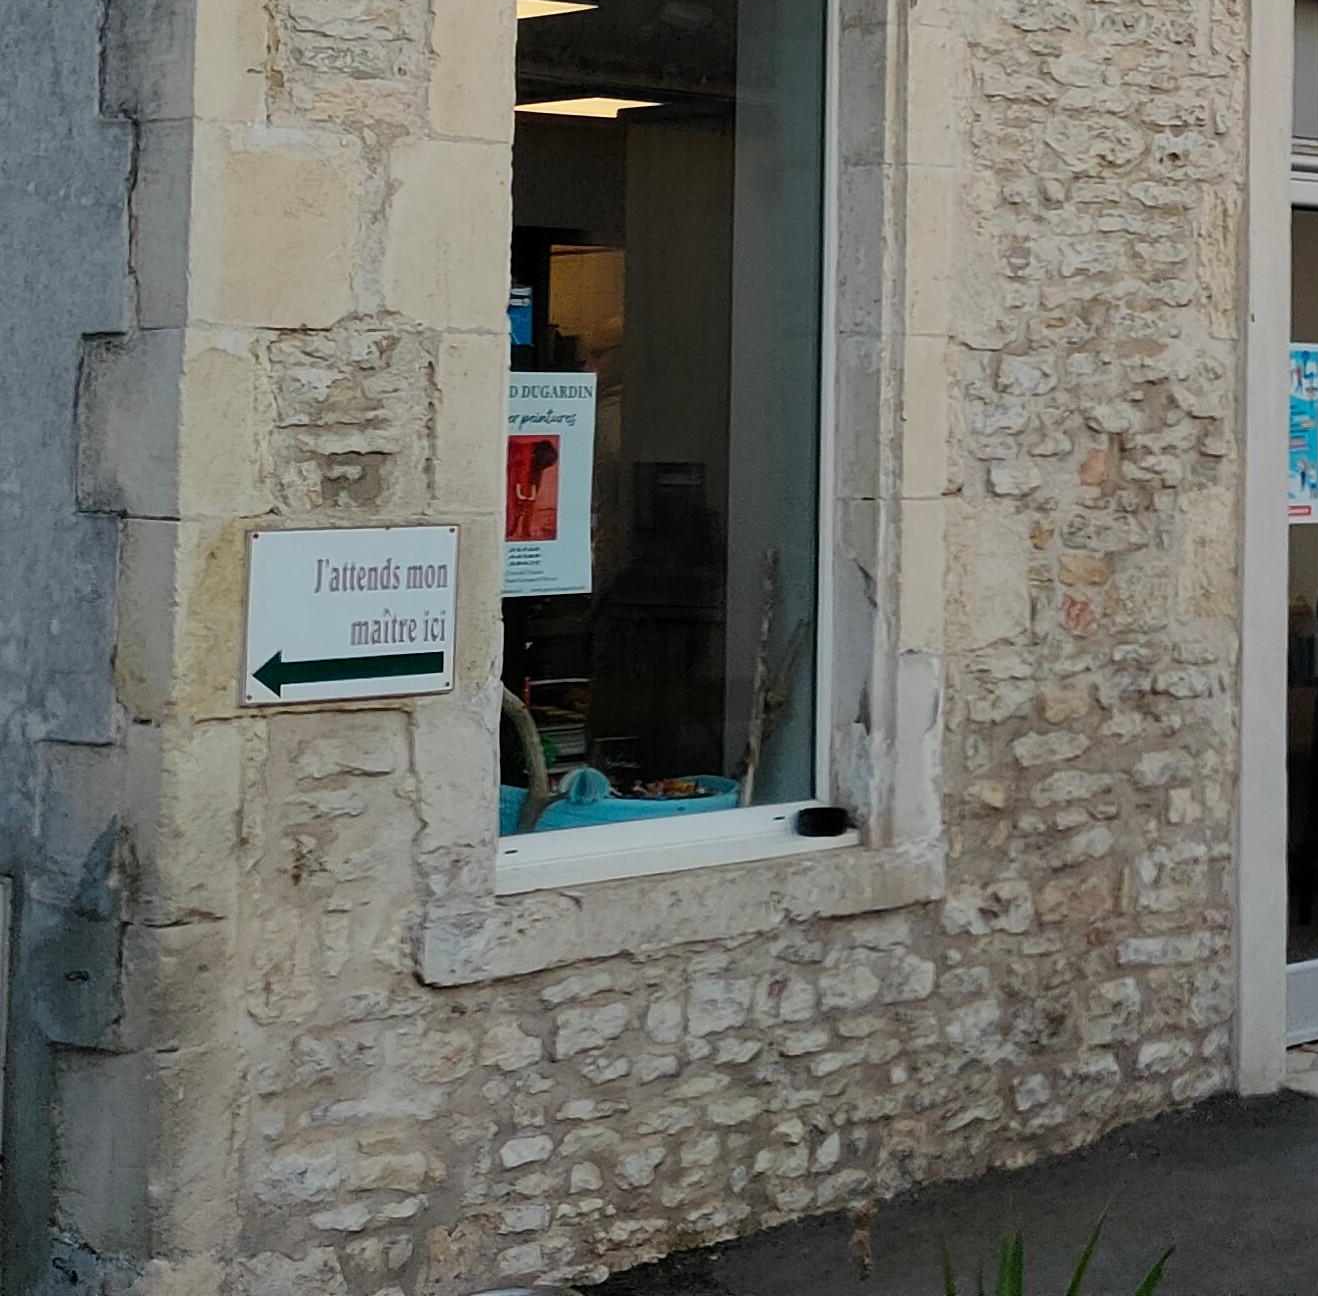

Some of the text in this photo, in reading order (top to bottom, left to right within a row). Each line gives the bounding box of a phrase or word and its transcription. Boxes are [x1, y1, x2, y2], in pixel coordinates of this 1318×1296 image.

[521, 385, 593, 399] DUGARDIN
[314, 558, 449, 594] J'attends mon
[349, 607, 447, 646] maître ici
